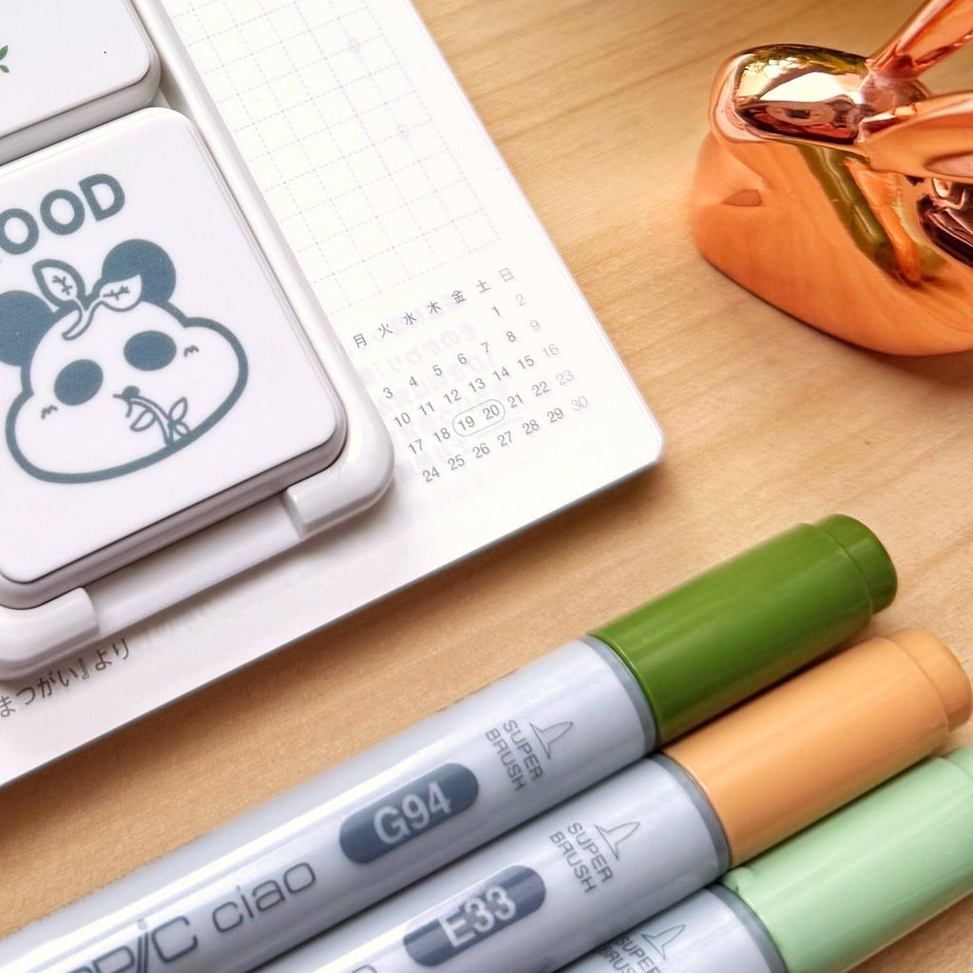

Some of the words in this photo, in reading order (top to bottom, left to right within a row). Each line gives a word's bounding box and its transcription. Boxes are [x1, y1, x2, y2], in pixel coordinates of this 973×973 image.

[353, 333, 368, 348] 月
[378, 323, 393, 338] 火
[403, 312, 417, 326] 水
[427, 300, 441, 314] 木
[451, 290, 466, 305] 金
[476, 280, 491, 294] 土
[499, 268, 514, 282] 日
[492, 306, 501, 317] 1
[515, 294, 526, 306] 2
[383, 387, 393, 399] 3
[408, 376, 418, 387] 4
[433, 365, 443, 376] 5
[458, 353, 467, 365] 6
[481, 342, 490, 353] 7
[506, 331, 516, 342] 8
[530, 320, 540, 331] 9
[394, 413, 411, 427] 10
[419, 402, 435, 416] 11
[443, 389, 462, 404] 12
[468, 377, 485, 393] 13
[493, 367, 510, 382] 14
[517, 355, 535, 370] 15
[542, 343, 559, 358] 16
[408, 439, 423, 454] 17
[433, 427, 451, 443] 18
[458, 415, 475, 431] 19
[482, 404, 500, 420] 20
[507, 393, 523, 408] 21
[532, 381, 550, 396] 22
[556, 370, 574, 385] 23
[423, 466, 440, 483] 24
[447, 455, 465, 471] 25
[472, 443, 490, 459] 26
[497, 431, 513, 447] 27
[522, 420, 539, 435] 28
[547, 407, 564, 423] 29
[571, 396, 588, 411] 30
[485, 728, 527, 791] BRUSH
[502, 718, 544, 783] SUPER
[372, 781, 452, 846] G94
[549, 831, 598, 894] BRUSH
[567, 820, 614, 884] SUPER
[211, 861, 317, 934] ciao
[438, 884, 517, 949] E33
